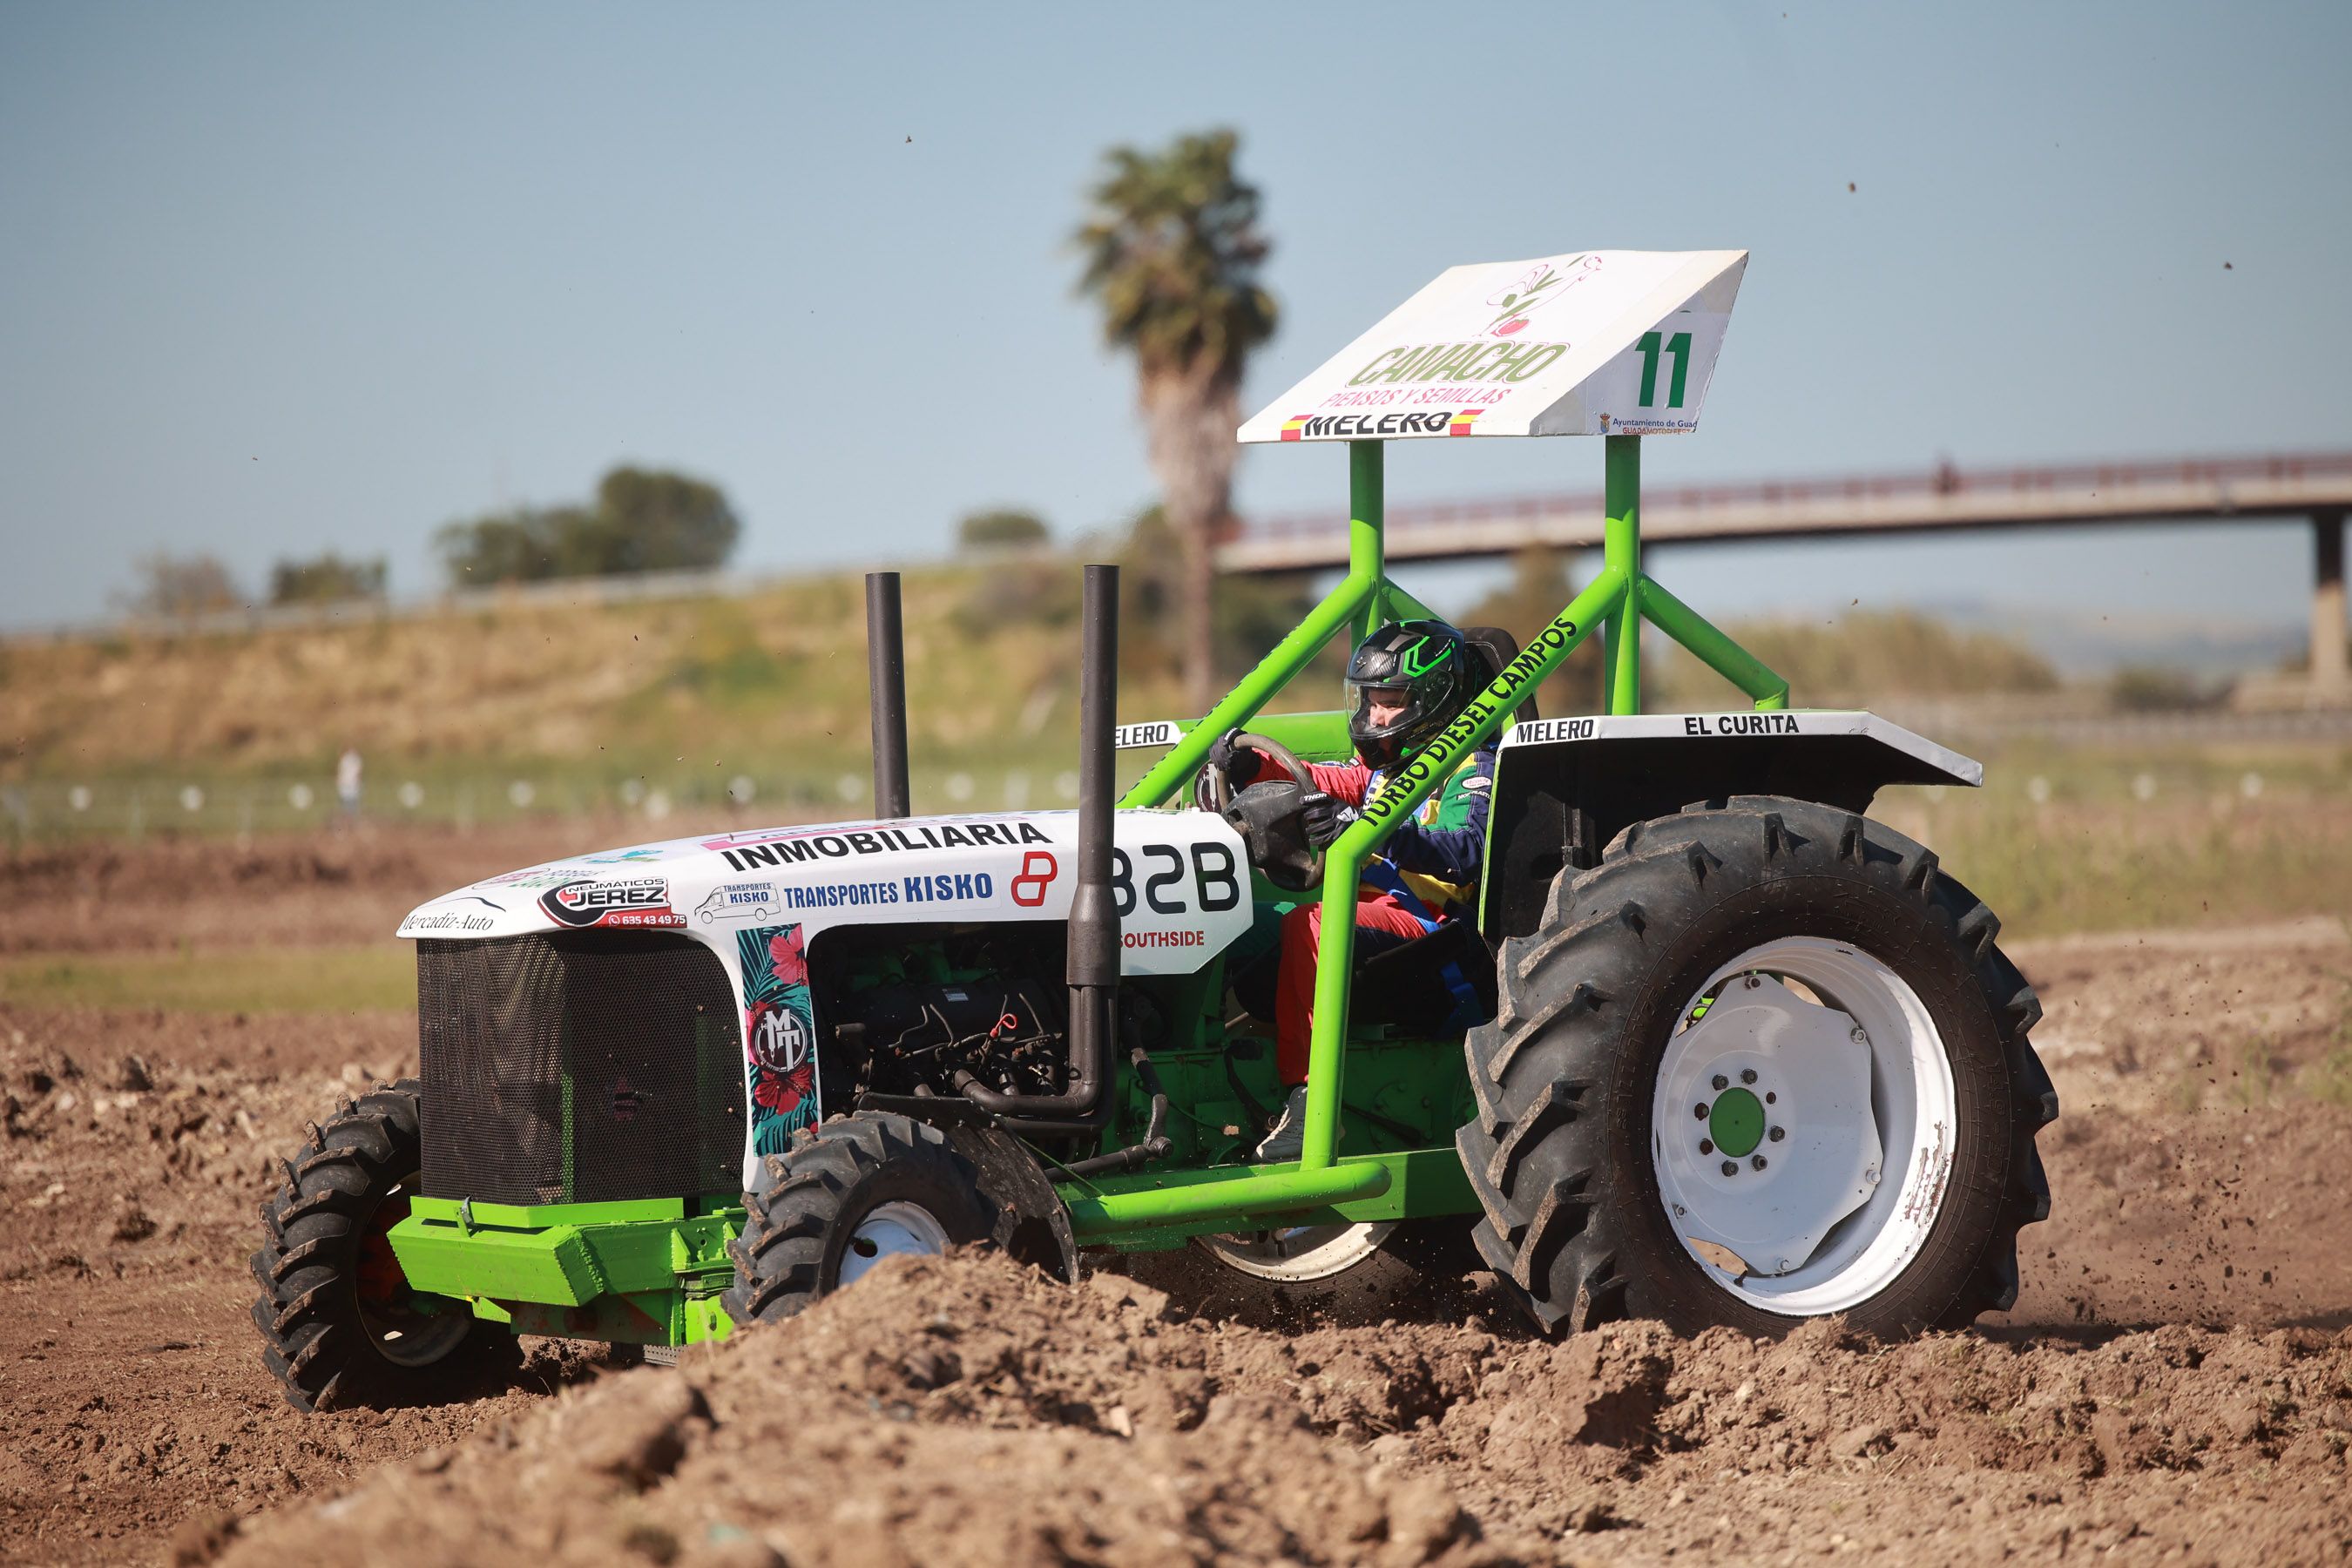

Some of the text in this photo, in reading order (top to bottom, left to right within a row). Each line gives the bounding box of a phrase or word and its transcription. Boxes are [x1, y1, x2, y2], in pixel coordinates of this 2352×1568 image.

[1347, 341, 1570, 387] CAMACHO
[1635, 332, 1692, 408] 11
[1318, 389, 1511, 408] PIENSOS Y SEMILLAS
[1305, 412, 1452, 436] MELERO
[1612, 418, 1664, 428] Ayuntamiento
[1360, 617, 1578, 827] TURBO DIESEL CAMPOS
[1517, 720, 1593, 743] MELERO
[1685, 715, 1800, 735] EL CURITA
[1116, 724, 1168, 748] ELERO
[720, 822, 1054, 871] INMOBILIARIA
[568, 878, 665, 893] NEUMÁTICOS
[723, 882, 772, 892] TRANSPORTES
[784, 873, 993, 909] TRANSPORTES KISKO
[569, 887, 665, 906] JEREZ
[729, 892, 769, 903] KISKO
[622, 914, 686, 925] 635 43 49 75
